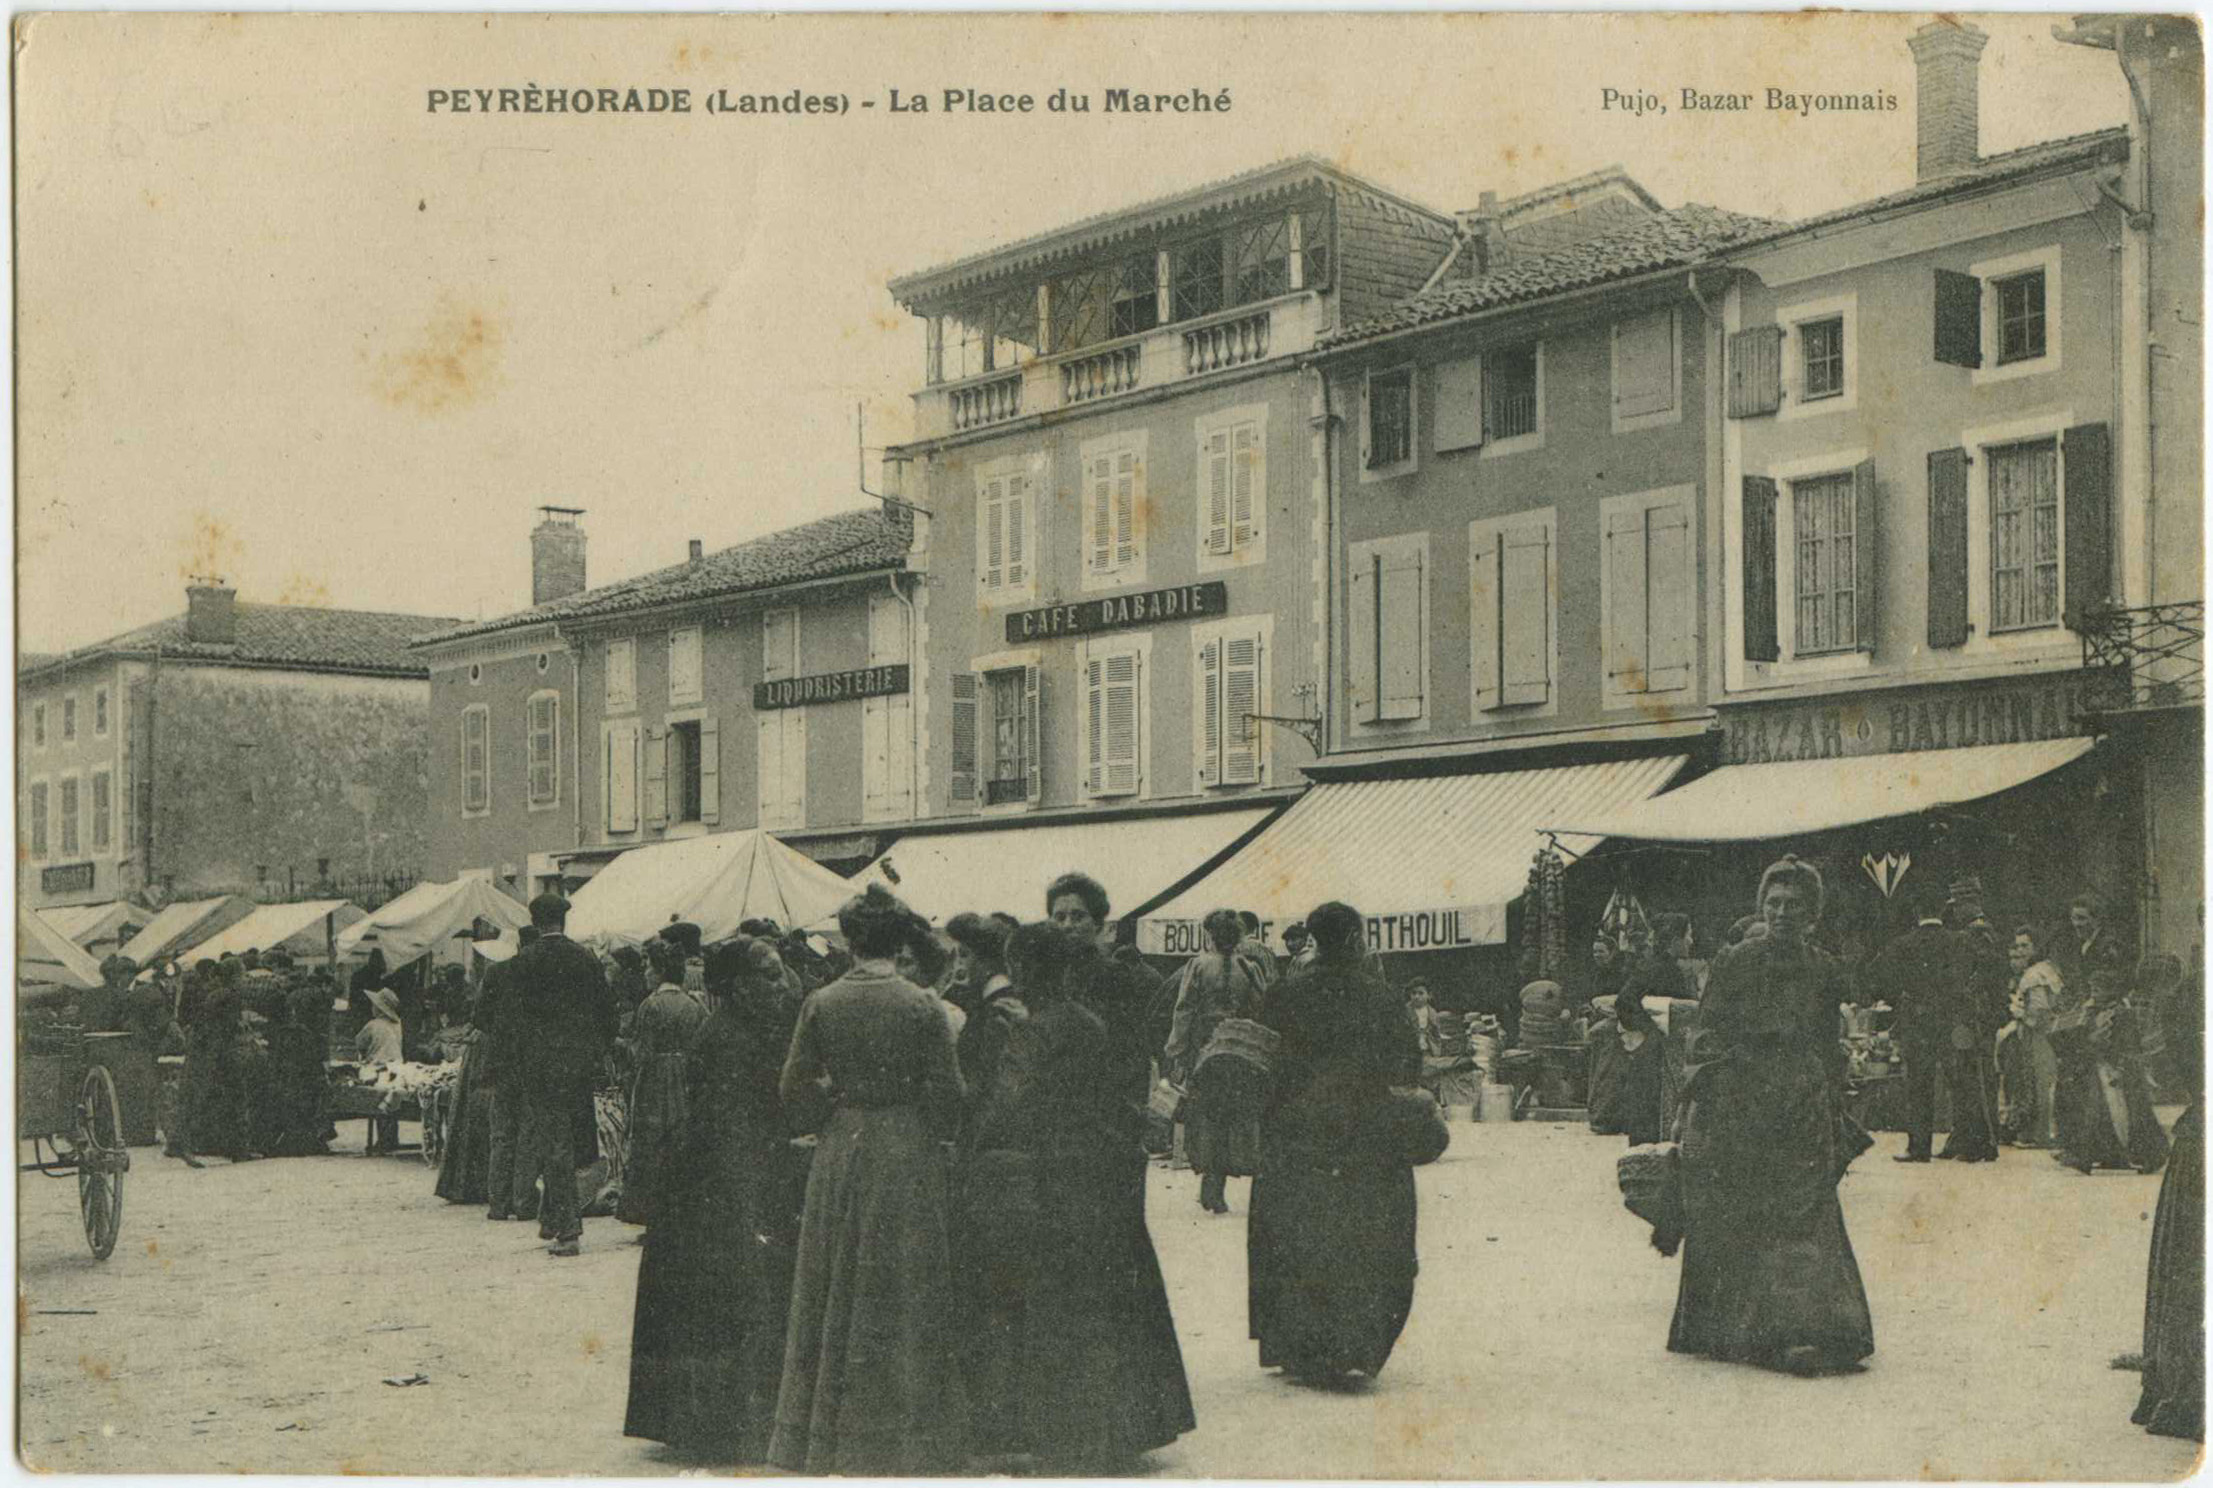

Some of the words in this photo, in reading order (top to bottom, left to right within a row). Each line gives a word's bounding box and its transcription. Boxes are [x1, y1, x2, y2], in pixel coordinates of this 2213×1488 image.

[1021, 605, 1079, 635] CAFE
[1102, 586, 1204, 624] DABADIE
[766, 667, 894, 705] LIQUORISTERIE
[1729, 707, 1843, 764] BAZAR
[1366, 910, 1472, 949] RTHOUIL
